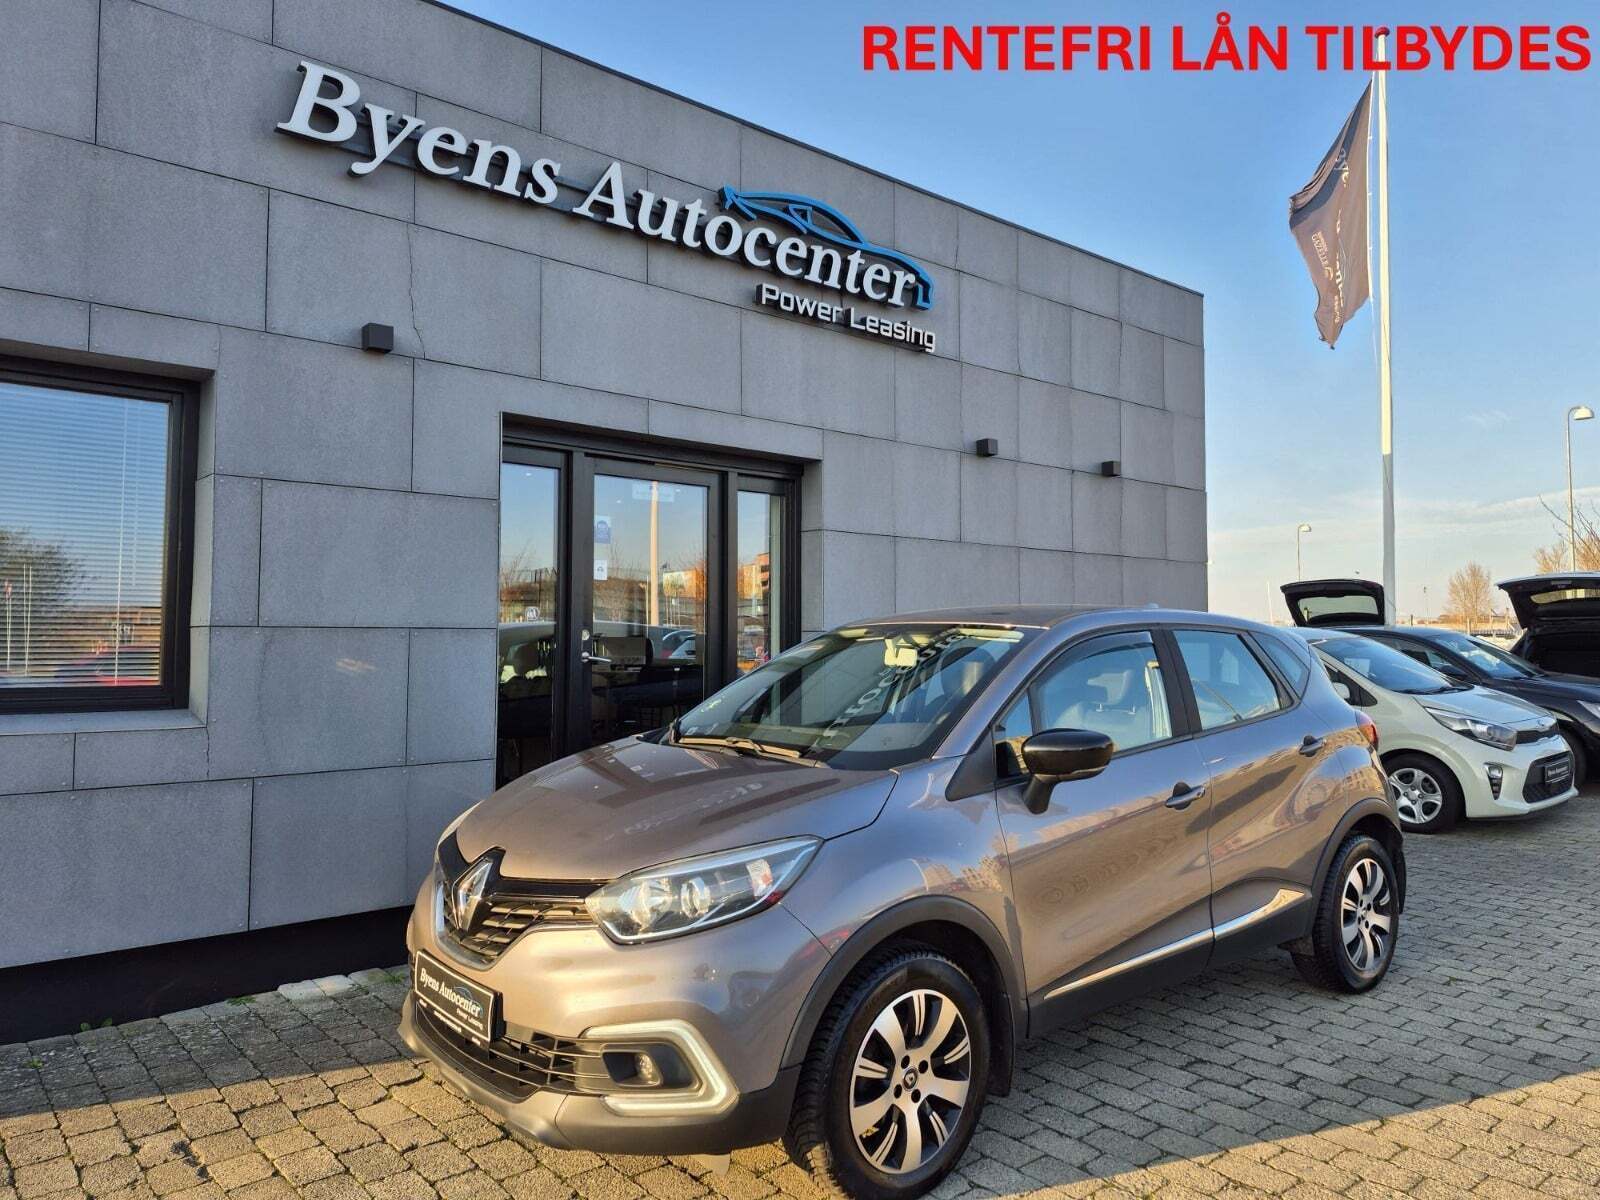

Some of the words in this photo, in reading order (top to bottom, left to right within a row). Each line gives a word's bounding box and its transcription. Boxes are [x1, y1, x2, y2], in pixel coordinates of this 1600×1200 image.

[276, 60, 561, 204] Byens
[572, 161, 915, 306] Autocenter
[760, 283, 843, 323] Power
[850, 307, 936, 353] Leasing
[420, 967, 440, 991] Byens
[439, 981, 481, 1018] Autocenter
